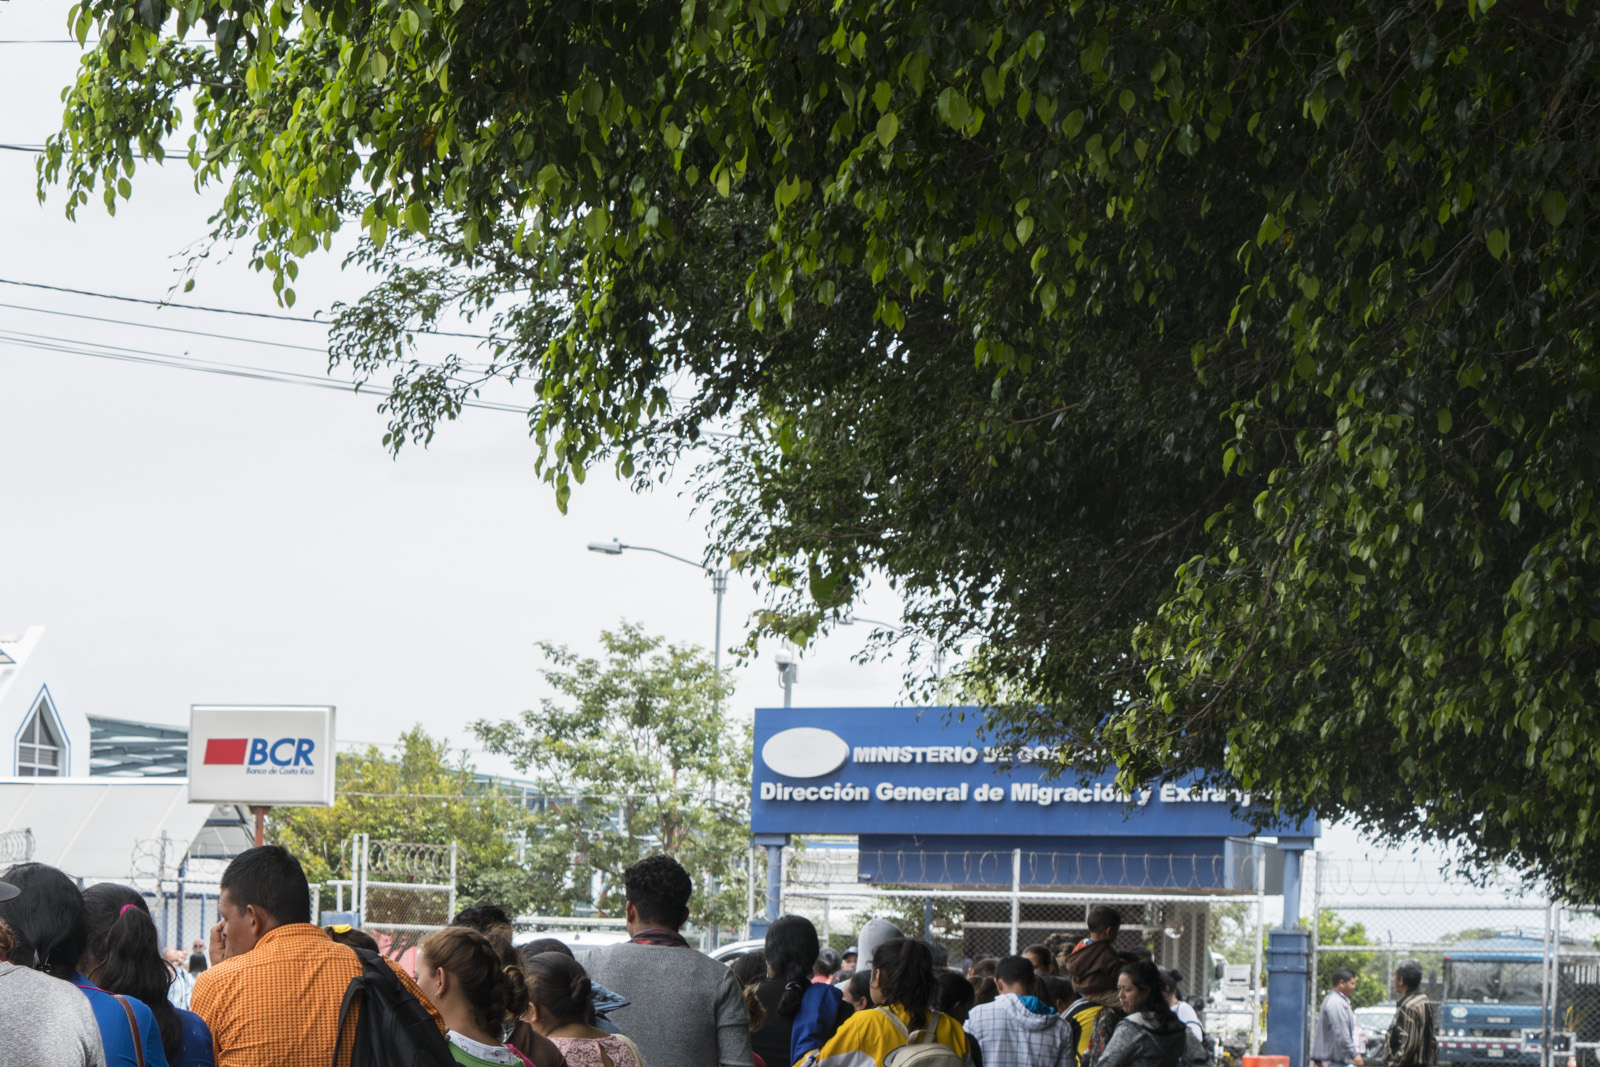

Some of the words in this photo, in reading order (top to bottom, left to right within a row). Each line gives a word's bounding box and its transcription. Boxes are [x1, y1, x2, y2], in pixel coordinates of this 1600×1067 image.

[248, 738, 315, 766] BCR
[853, 746, 978, 763] MINISTERIO
[246, 767, 267, 775] Banco
[268, 767, 278, 775] de
[279, 767, 298, 775] Costa
[299, 767, 315, 775] Rica
[760, 782, 869, 801] Dirección
[875, 782, 969, 801] General
[974, 783, 1005, 801] de
[1011, 783, 1131, 806] Migración
